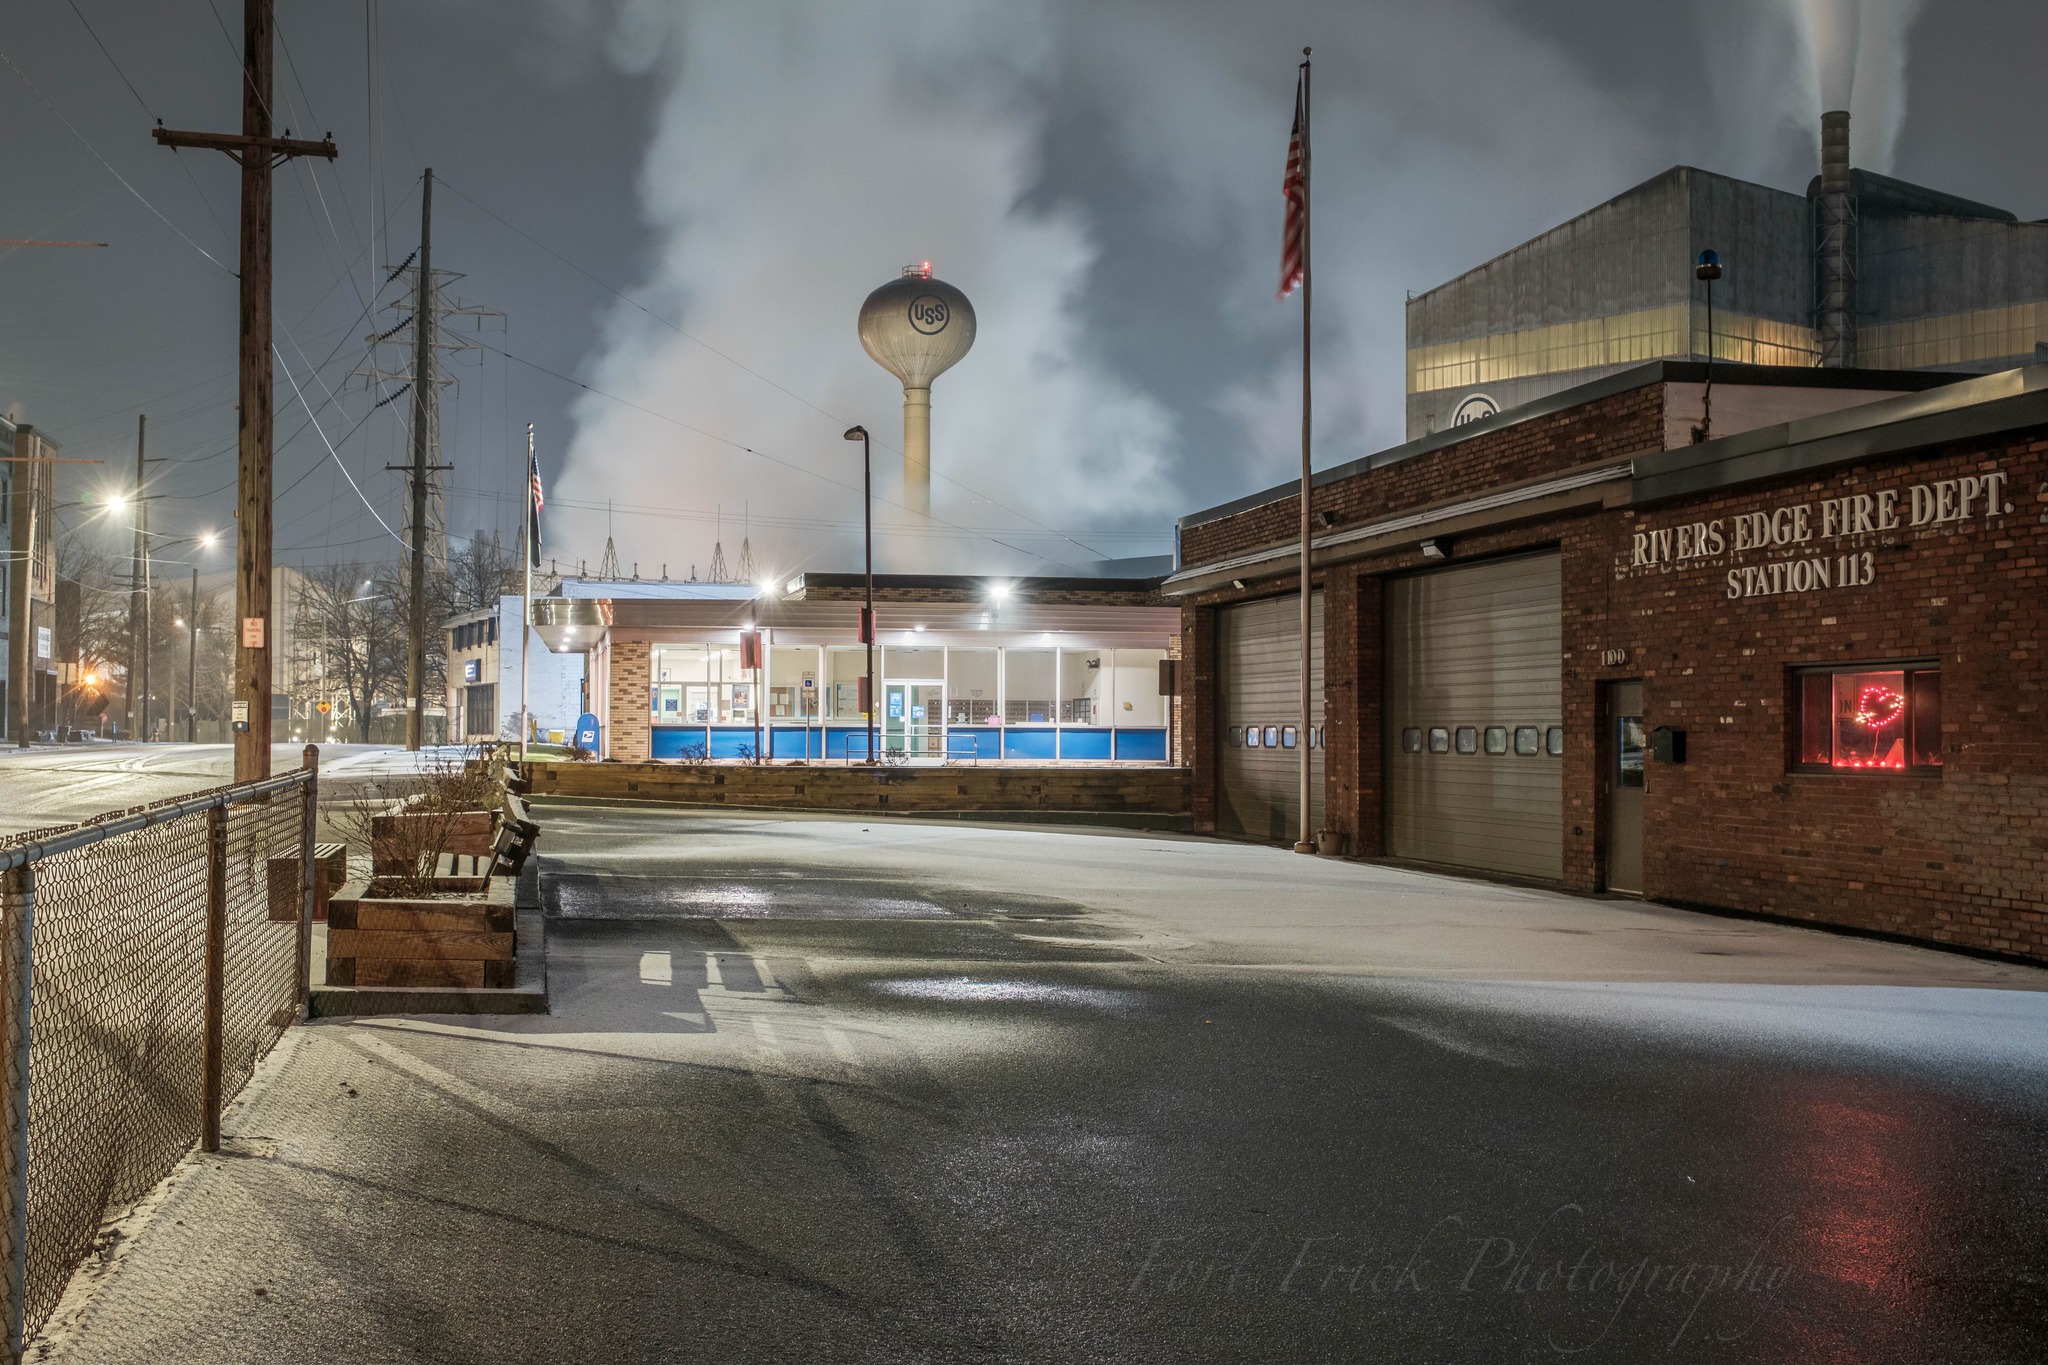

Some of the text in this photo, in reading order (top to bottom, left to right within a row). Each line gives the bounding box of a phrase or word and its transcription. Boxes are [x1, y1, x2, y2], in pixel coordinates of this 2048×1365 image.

[914, 304, 945, 325] USS
[1633, 471, 2015, 567] RIVERS EDGE FIRE DEPT.
[1727, 551, 1876, 600] STATION 113
[1600, 648, 1626, 666] 1100
